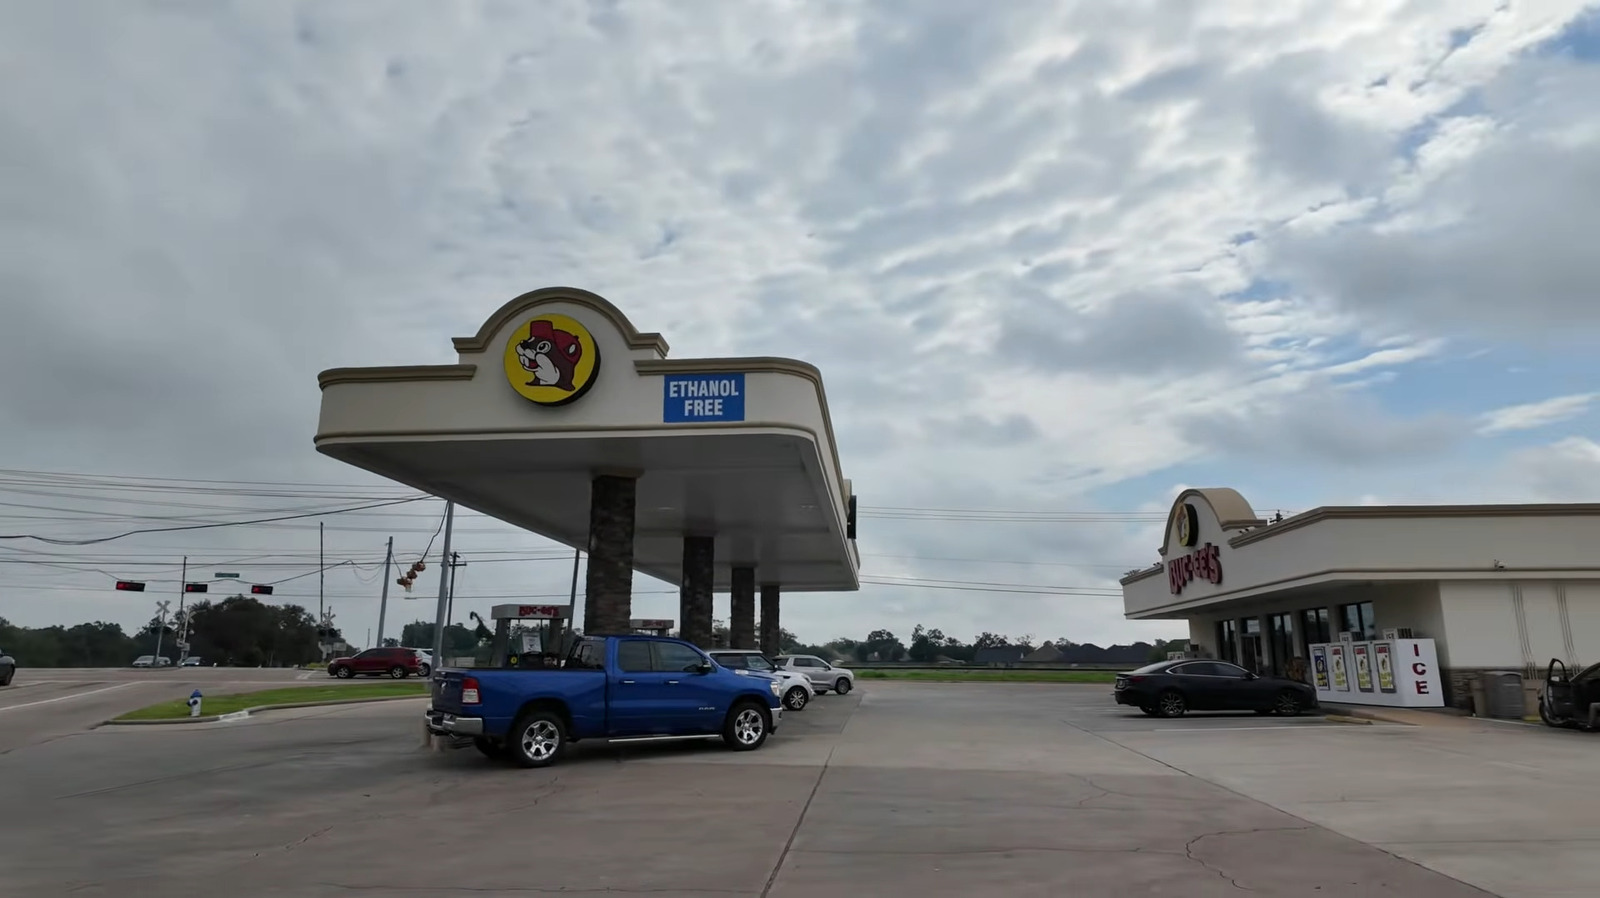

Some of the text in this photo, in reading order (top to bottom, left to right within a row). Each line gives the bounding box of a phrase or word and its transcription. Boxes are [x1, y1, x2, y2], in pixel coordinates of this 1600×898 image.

[669, 379, 739, 398] ETHANOL
[684, 399, 723, 417] FREE
[1412, 643, 1430, 694] ICE
